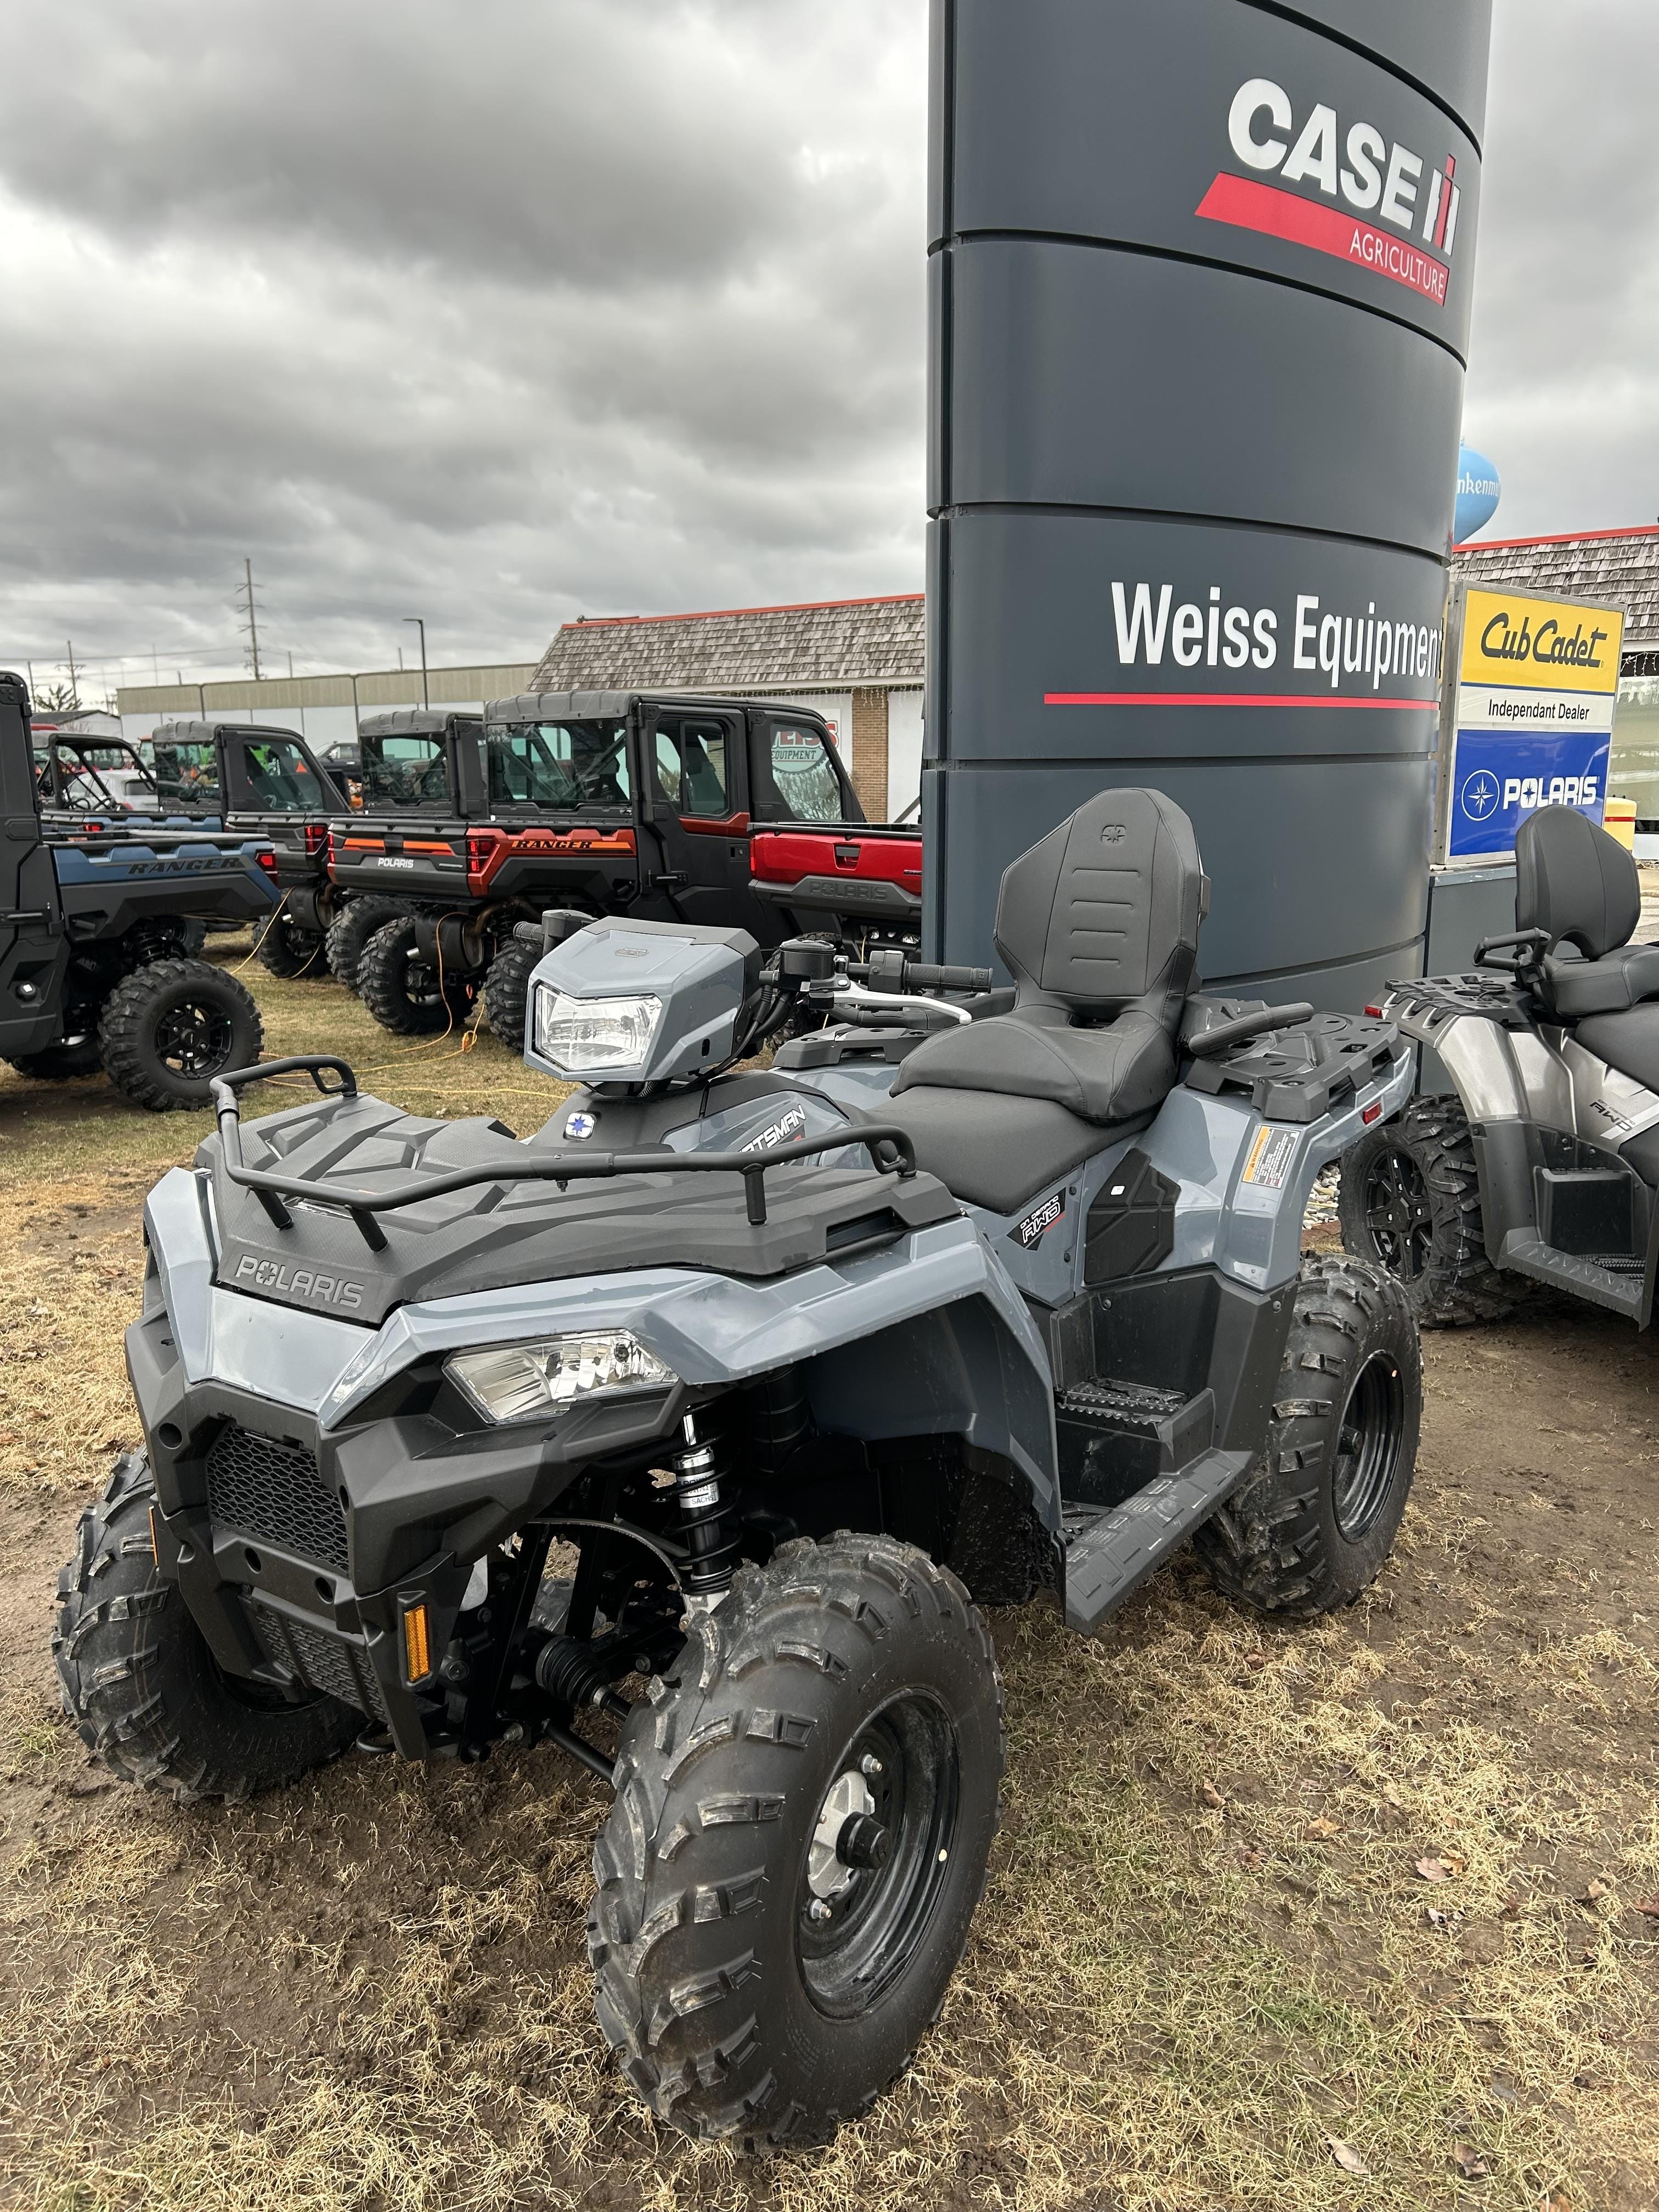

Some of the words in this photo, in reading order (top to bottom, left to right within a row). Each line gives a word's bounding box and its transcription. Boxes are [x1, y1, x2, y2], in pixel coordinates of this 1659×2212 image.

[1228, 77, 1424, 230] CASE
[1349, 228, 1444, 299] AGRICULTURE
[1110, 581, 1278, 669] Weiss
[1481, 612, 1531, 661] Cub
[1532, 619, 1608, 668] Cadet
[1488, 699, 1556, 721] Independant
[1558, 703, 1590, 720] Dealer
[1502, 776, 1598, 810] POLARIS
[515, 840, 592, 849] RANGER
[128, 857, 246, 875] RANGER
[377, 857, 414, 868] POLARIS
[809, 881, 888, 902] POLARIS
[1022, 1201, 1060, 1244] AWD
[235, 1254, 365, 1309] POLARIS
[691, 1494, 714, 1505] SACHS
